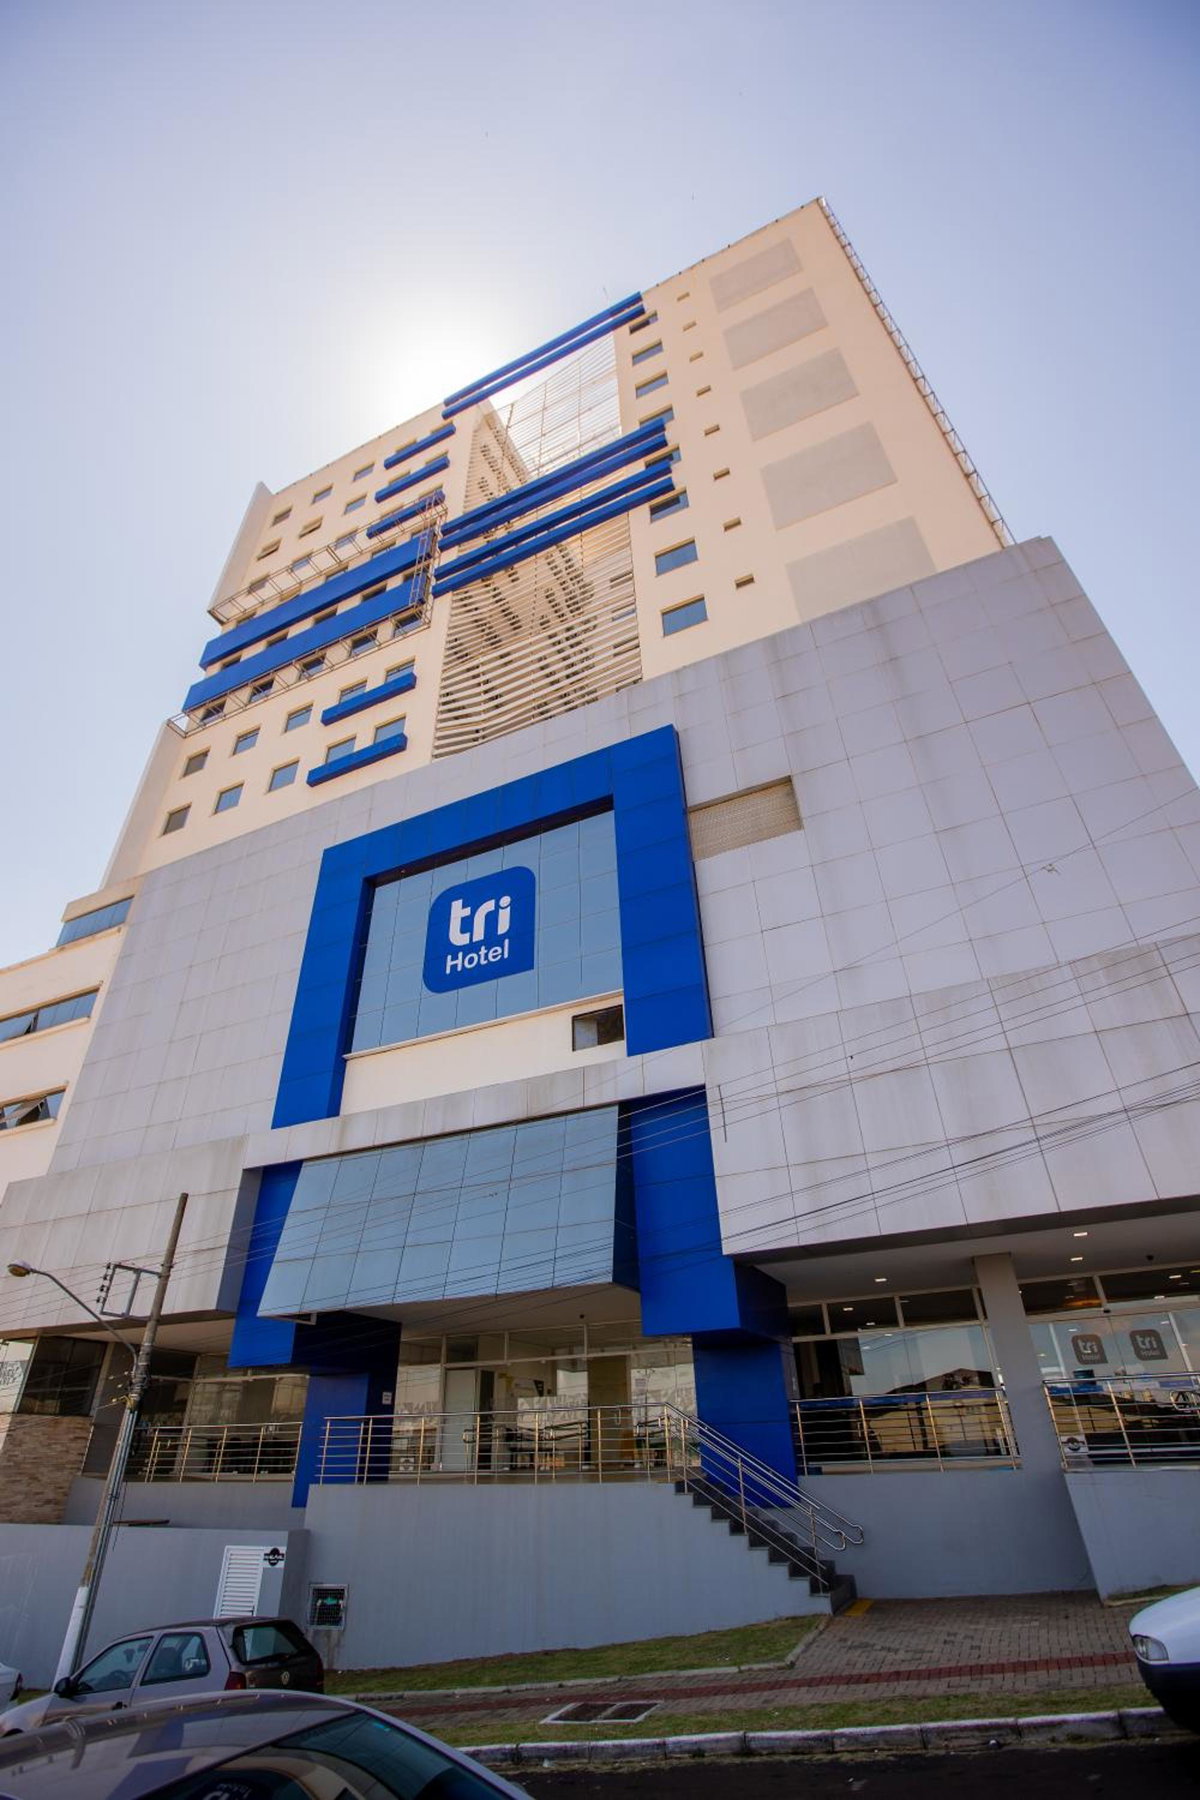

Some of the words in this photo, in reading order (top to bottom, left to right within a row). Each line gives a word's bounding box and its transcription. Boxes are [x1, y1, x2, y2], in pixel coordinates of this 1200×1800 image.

[449, 896, 511, 946] tri
[445, 939, 509, 975] Hotel
[1077, 1339, 1098, 1353] tri
[1135, 1334, 1157, 1349] tri
